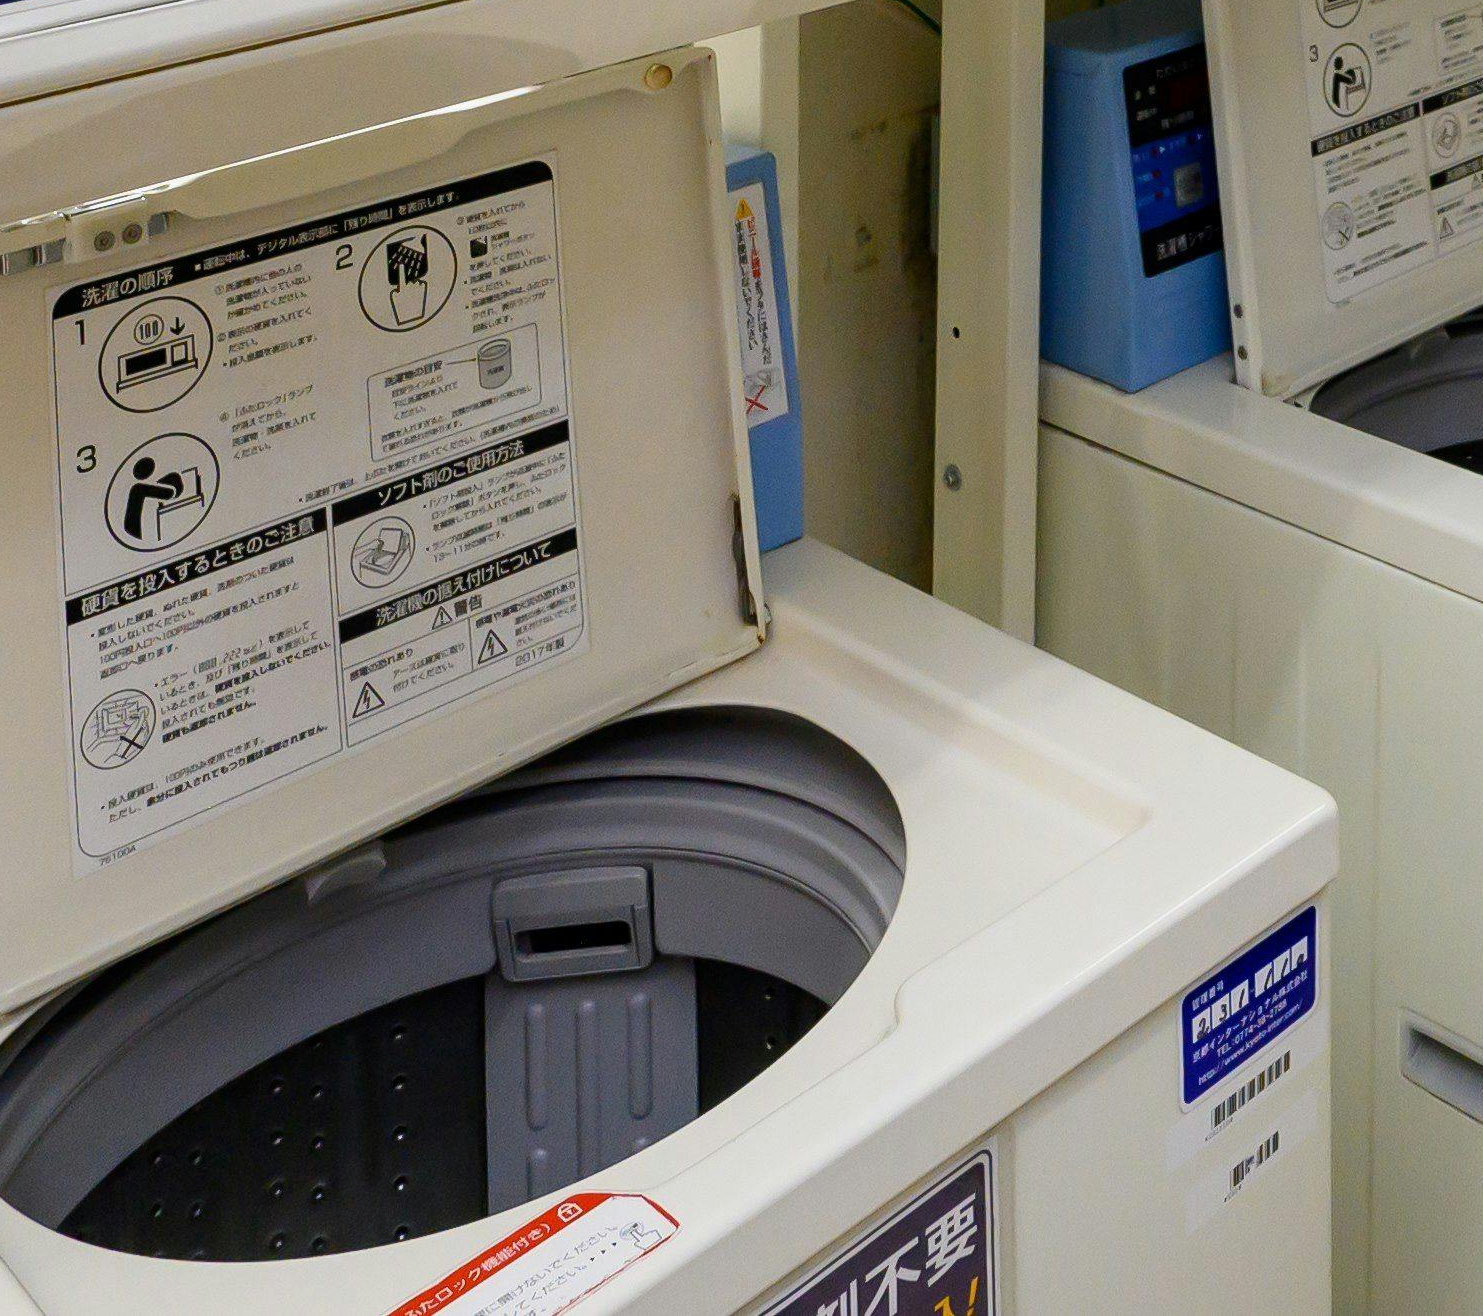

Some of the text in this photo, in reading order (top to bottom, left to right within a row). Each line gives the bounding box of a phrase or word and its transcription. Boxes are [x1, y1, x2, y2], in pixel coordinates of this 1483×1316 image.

[75, 243, 354, 345] 1 2
[81, 267, 175, 308] 洗濯の順序
[76, 445, 97, 473] 3
[81, 517, 316, 616] 硬貨を投入するときのご注意
